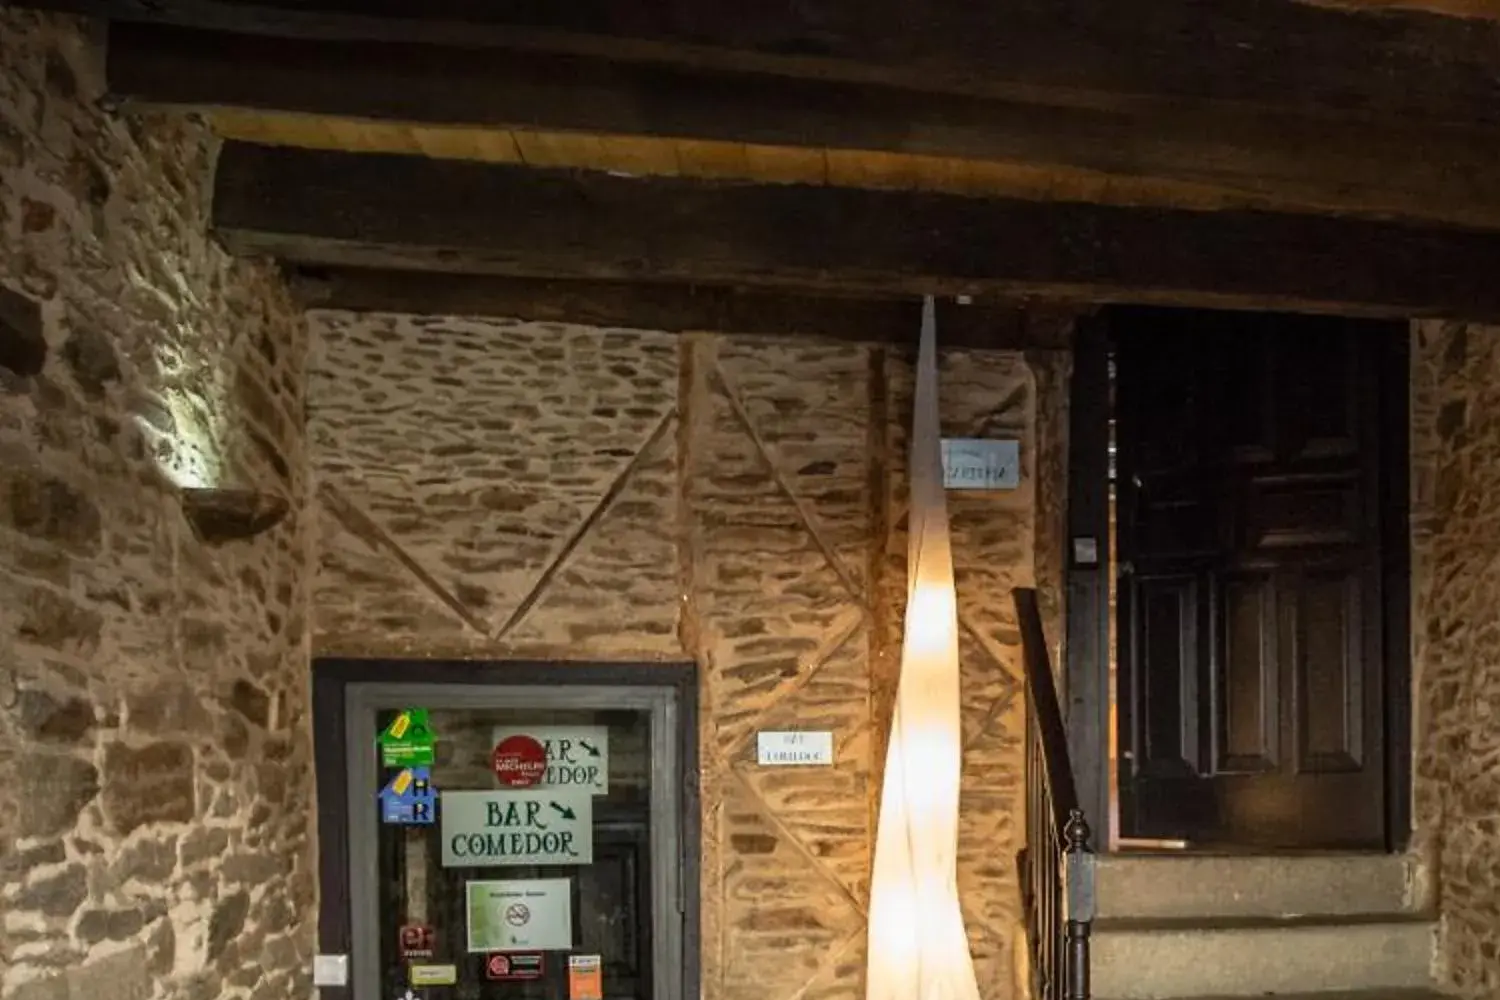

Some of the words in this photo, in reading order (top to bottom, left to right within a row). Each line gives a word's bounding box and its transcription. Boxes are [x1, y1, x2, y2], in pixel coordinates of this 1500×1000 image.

[544, 739, 577, 763] AR
[485, 800, 547, 829] BAR
[451, 831, 579, 857] COMEDOR
